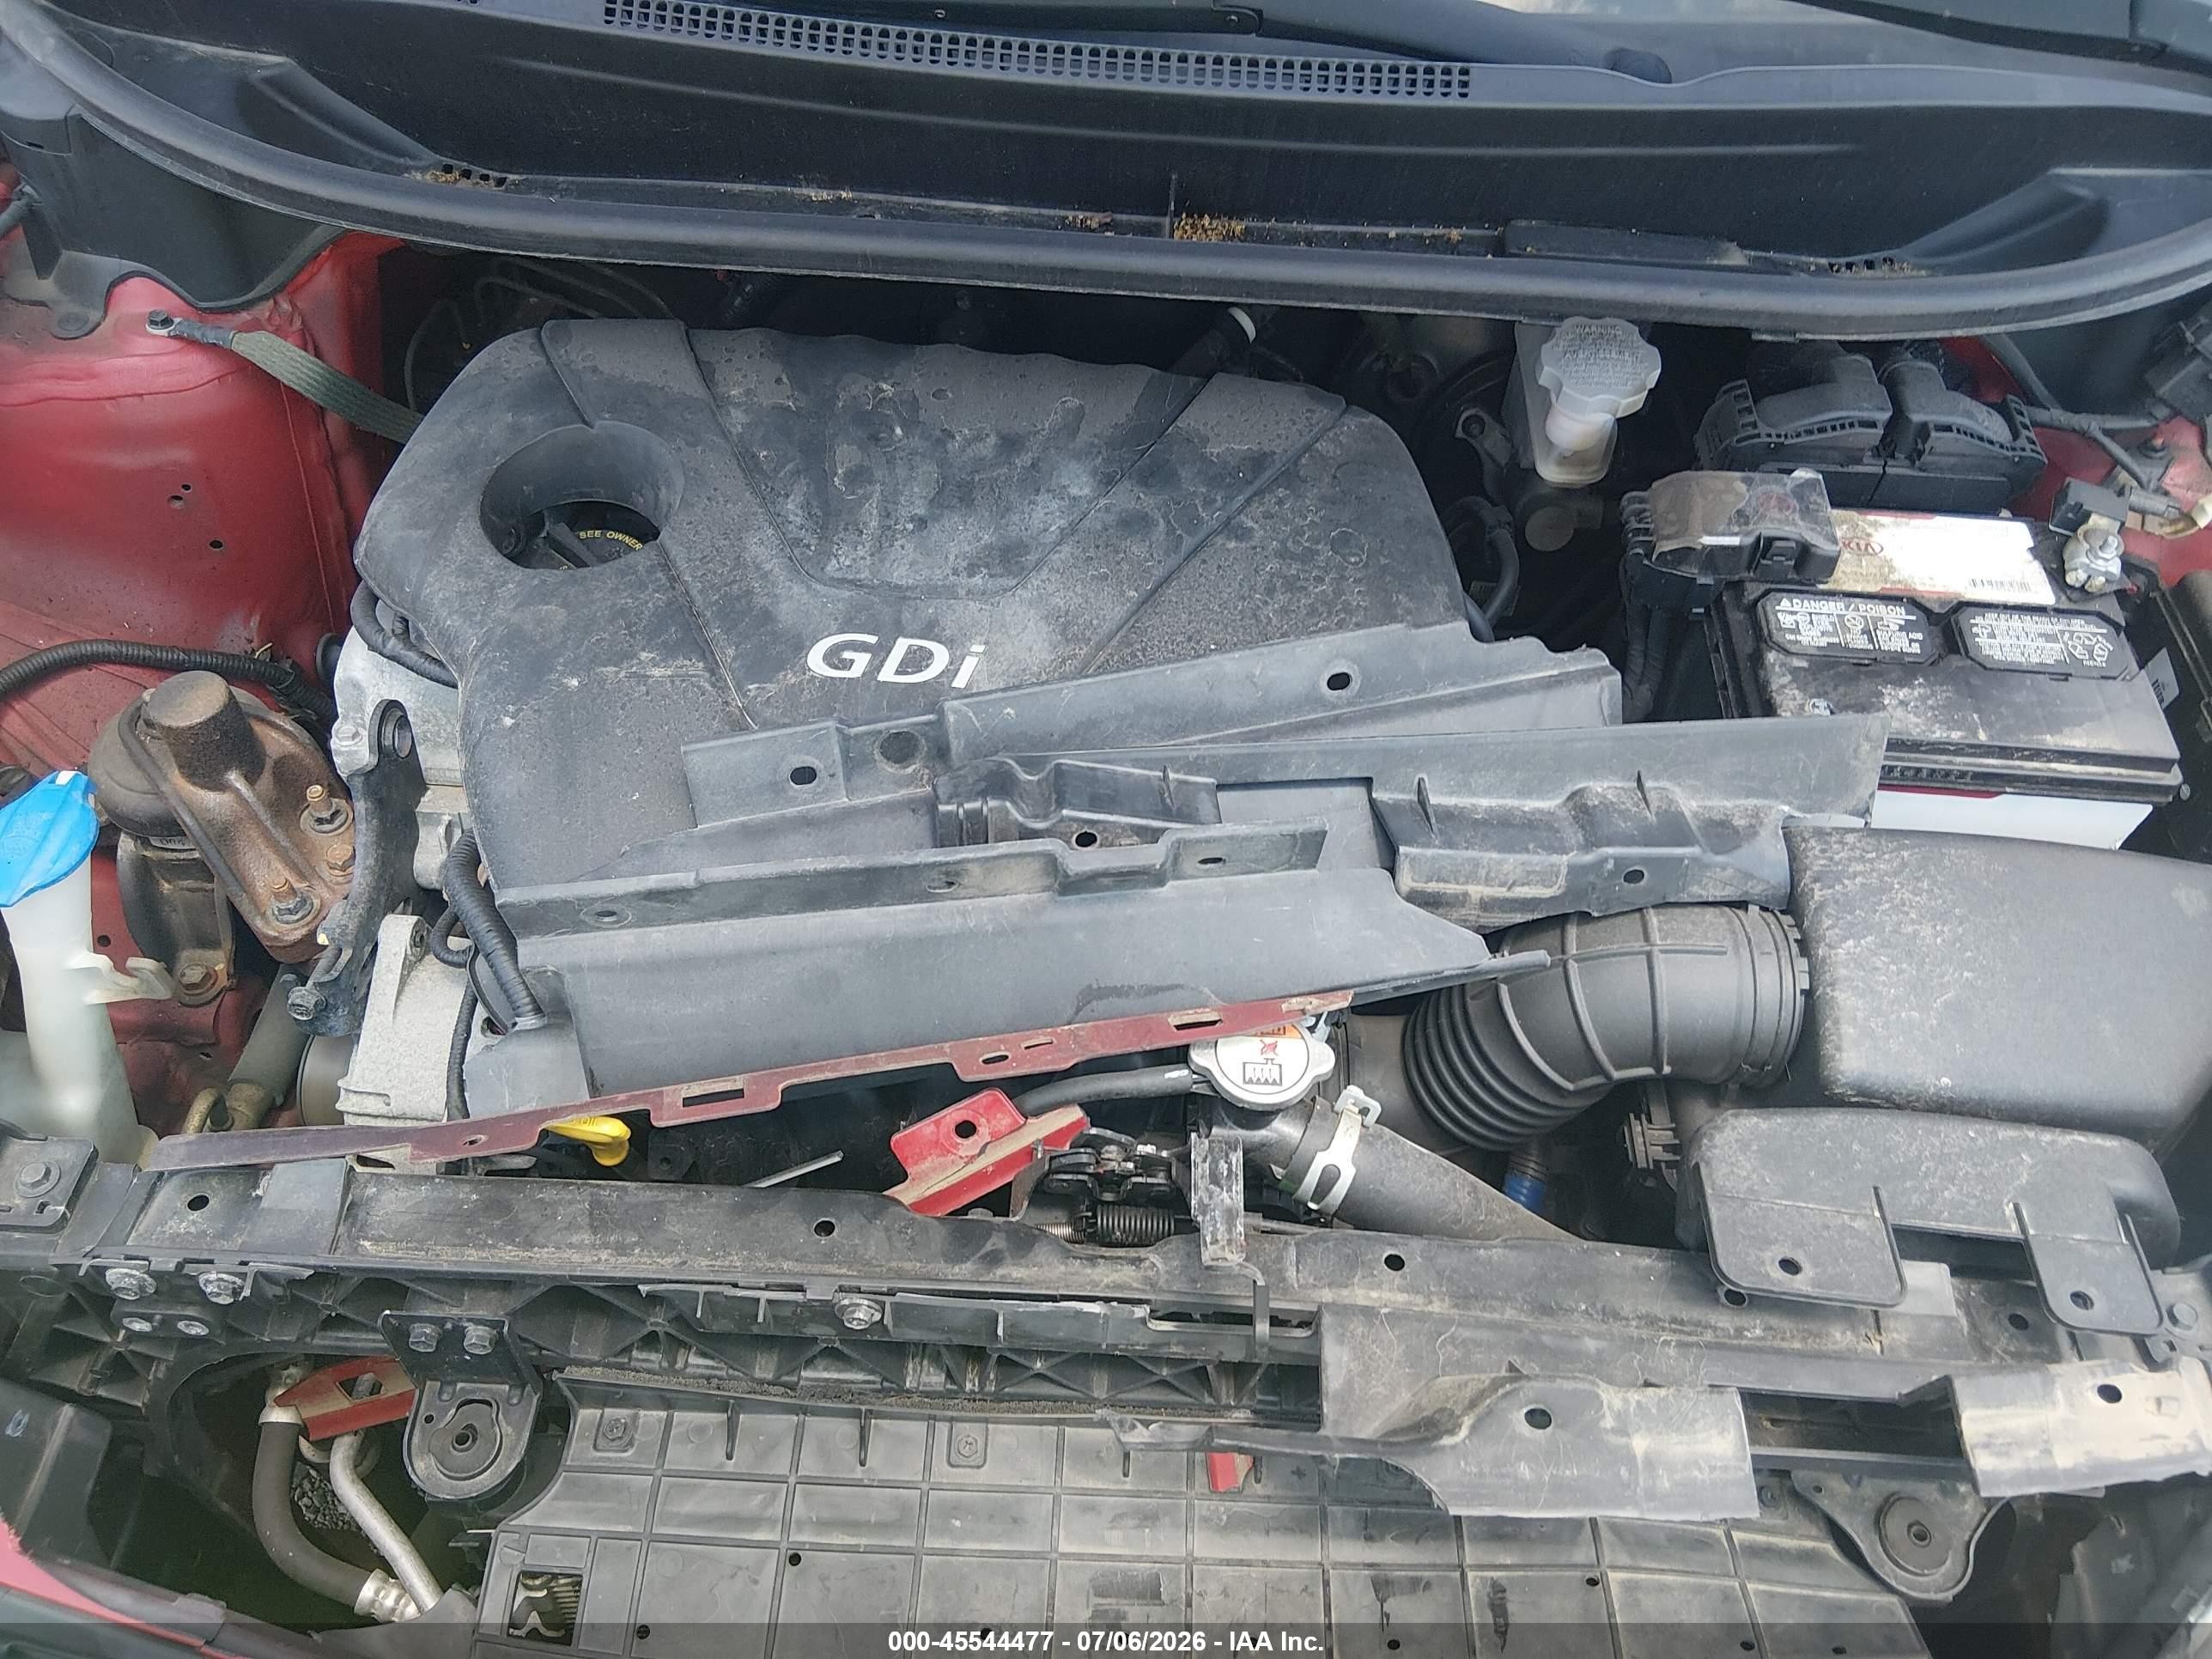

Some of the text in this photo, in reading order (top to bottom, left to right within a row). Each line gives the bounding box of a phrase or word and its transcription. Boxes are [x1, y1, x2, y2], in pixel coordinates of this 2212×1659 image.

[579, 530, 643, 550] SEE OWNER
[1792, 599, 1845, 612] DANGER
[1858, 604, 1906, 616] POISON
[806, 632, 988, 689] GDi
